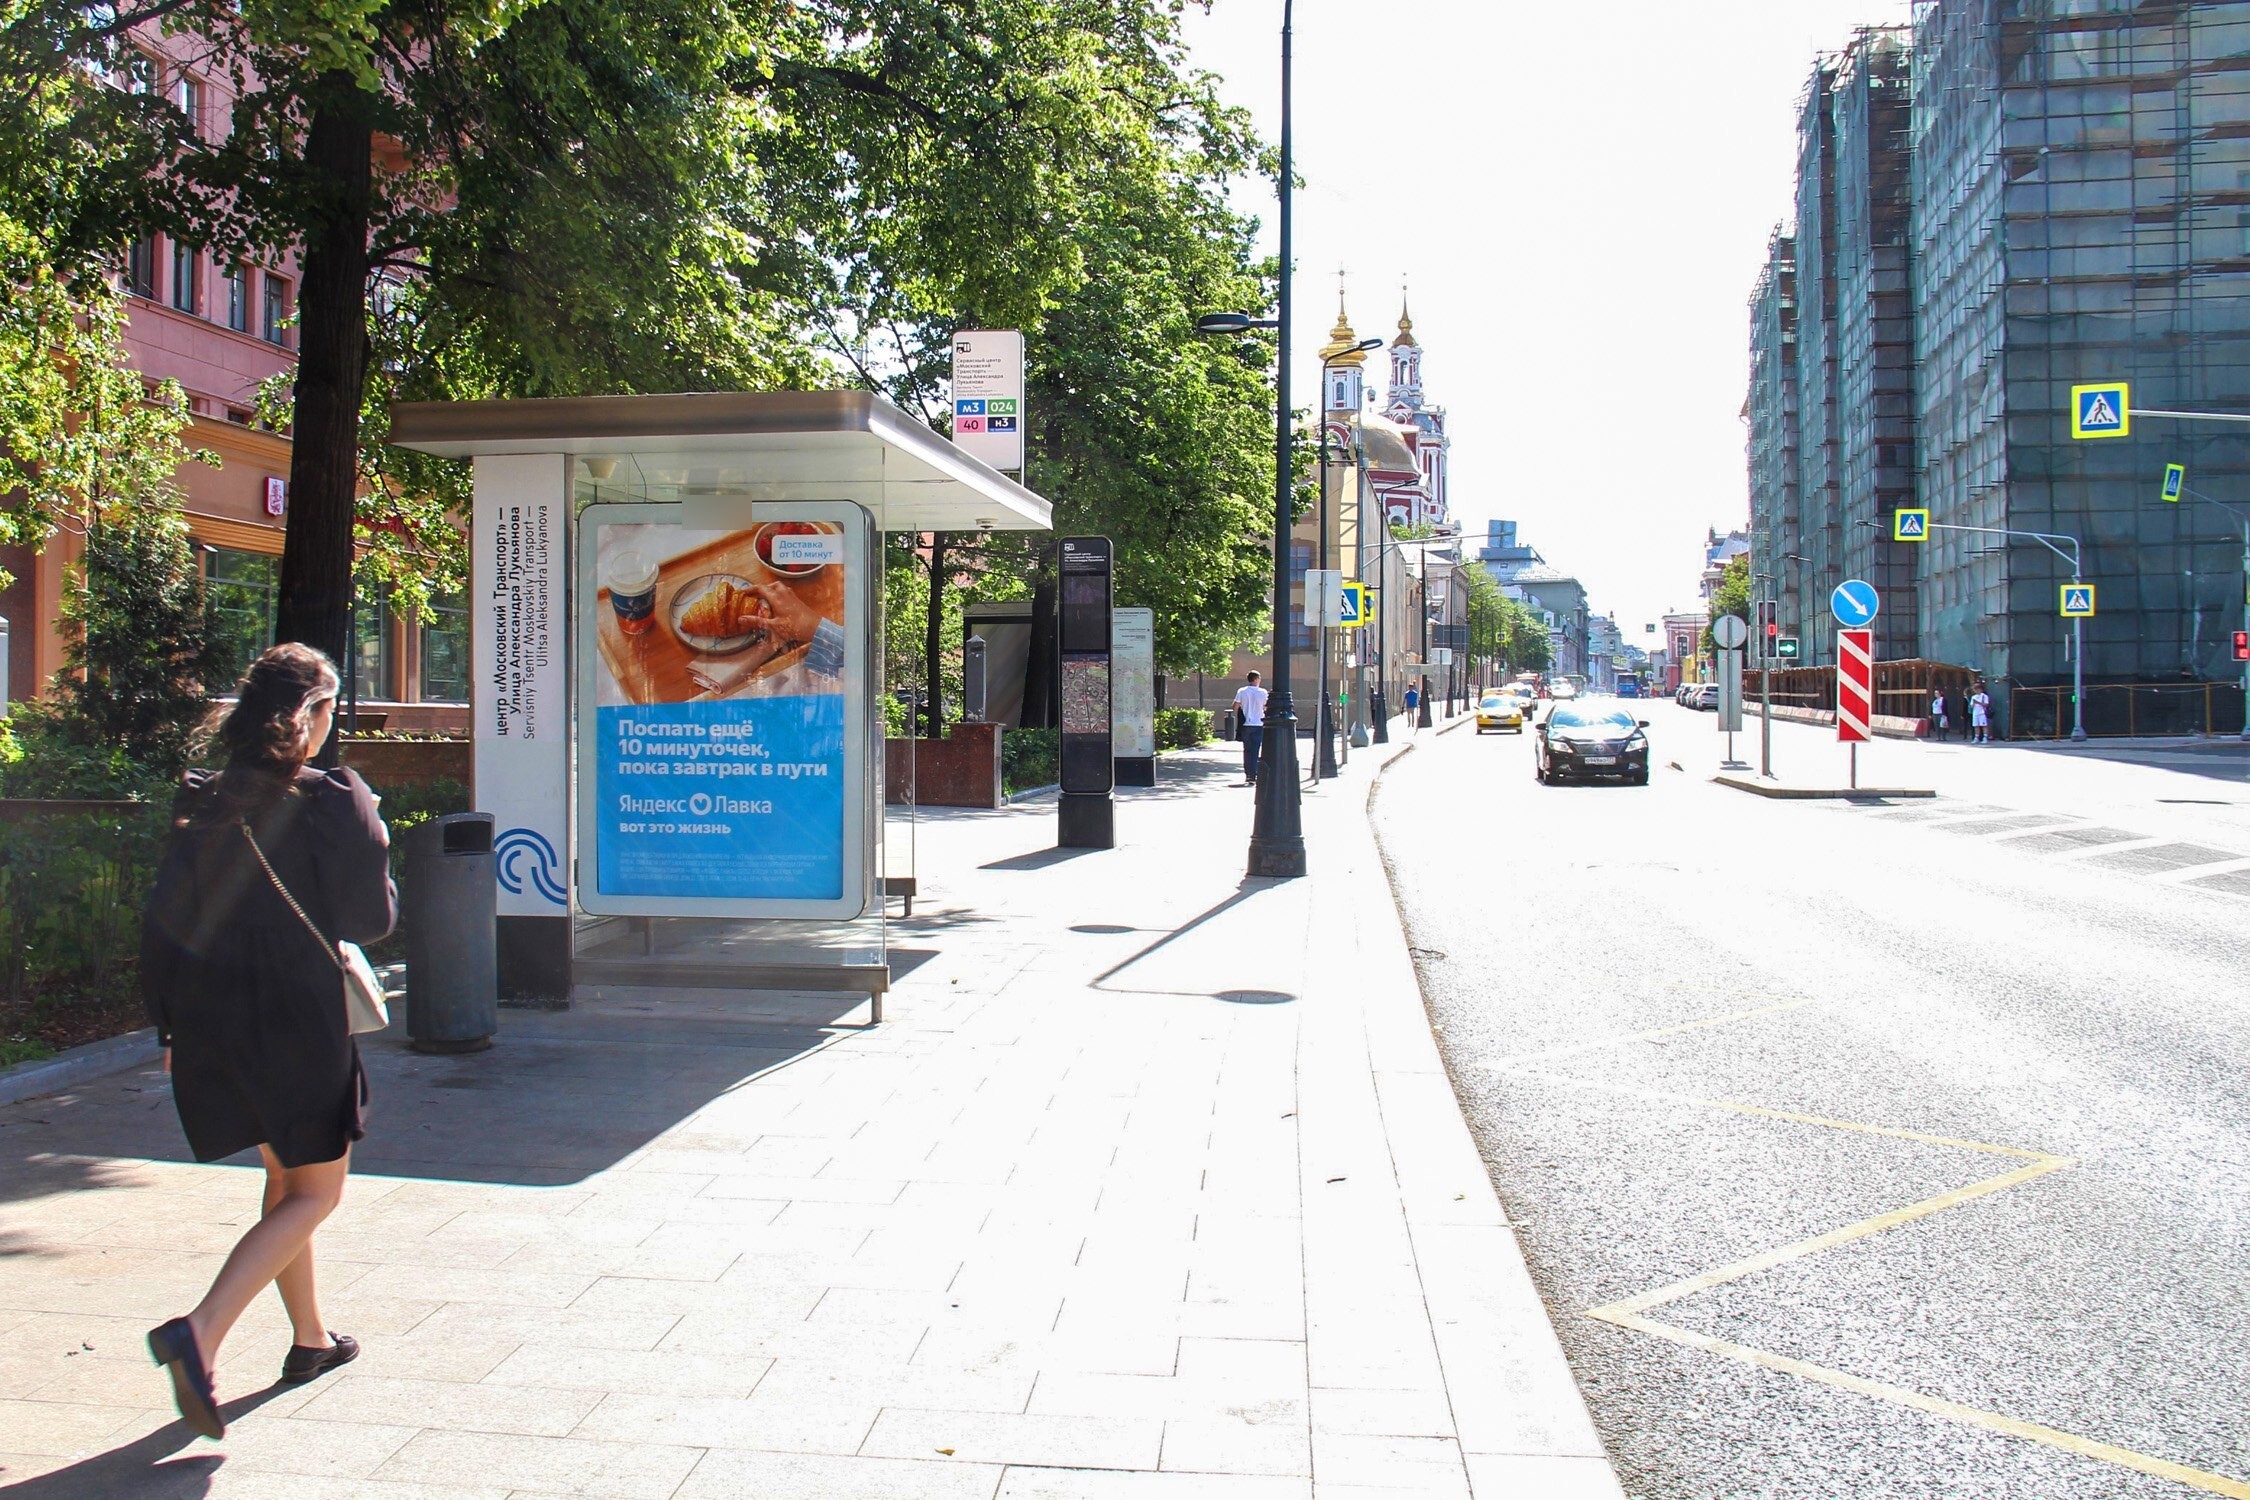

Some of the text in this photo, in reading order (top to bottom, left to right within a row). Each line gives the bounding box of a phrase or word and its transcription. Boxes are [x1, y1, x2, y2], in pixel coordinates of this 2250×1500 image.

[990, 402, 1014, 413] 024
[963, 420, 979, 430] 40
[522, 521, 536, 576] Transport
[779, 540, 823, 550] Доставка
[792, 550, 802, 558] 10
[804, 551, 833, 559] минут
[493, 524, 509, 600] Транспорт»
[536, 505, 549, 667] Ulitsa Aleksandra Lukyanova
[509, 507, 522, 714] Улица Александра Лукьянова
[523, 578, 537, 645] Moskovskiy
[493, 606, 507, 693] «Московский
[522, 649, 534, 685] Tsentr
[496, 698, 510, 736] центр
[523, 688, 537, 740] Servisniy
[618, 719, 753, 740] Поспать ещё
[618, 739, 770, 759] 10 минуточек,
[618, 762, 828, 780] пока завтрак в пути
[619, 794, 772, 815] Яндекс Лавка
[619, 822, 731, 834] вот это жизнь
